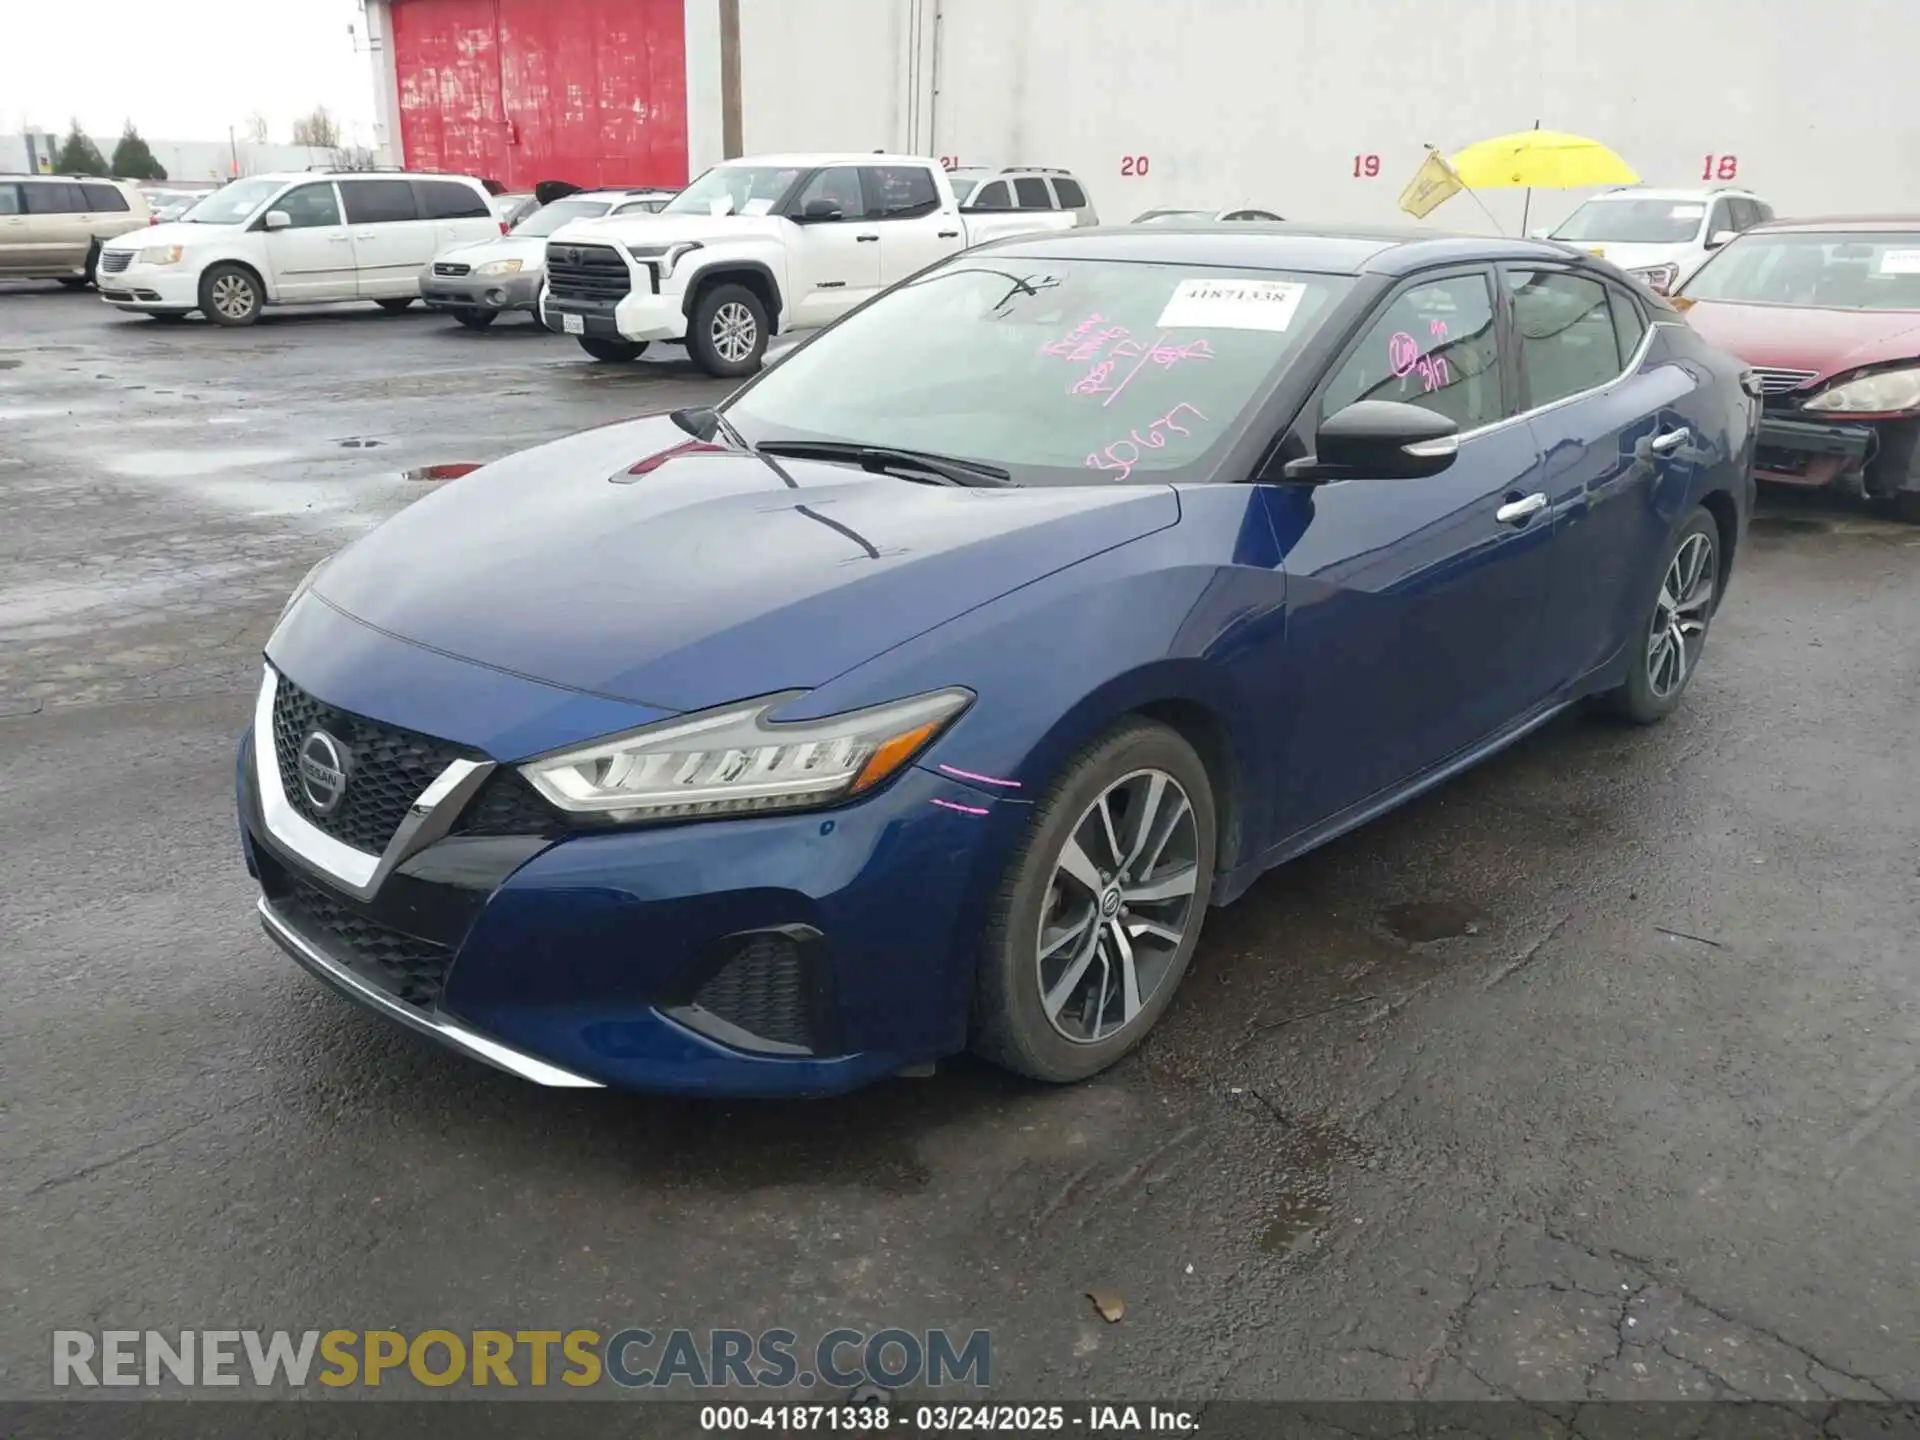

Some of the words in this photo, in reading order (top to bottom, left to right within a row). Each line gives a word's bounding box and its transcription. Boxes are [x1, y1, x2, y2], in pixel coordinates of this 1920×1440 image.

[1121, 156, 1149, 176] 20
[1353, 155, 1380, 178] 19
[1702, 155, 1737, 180] 18
[1186, 289, 1286, 302] 41871338
[305, 761, 337, 788] NISSAN
